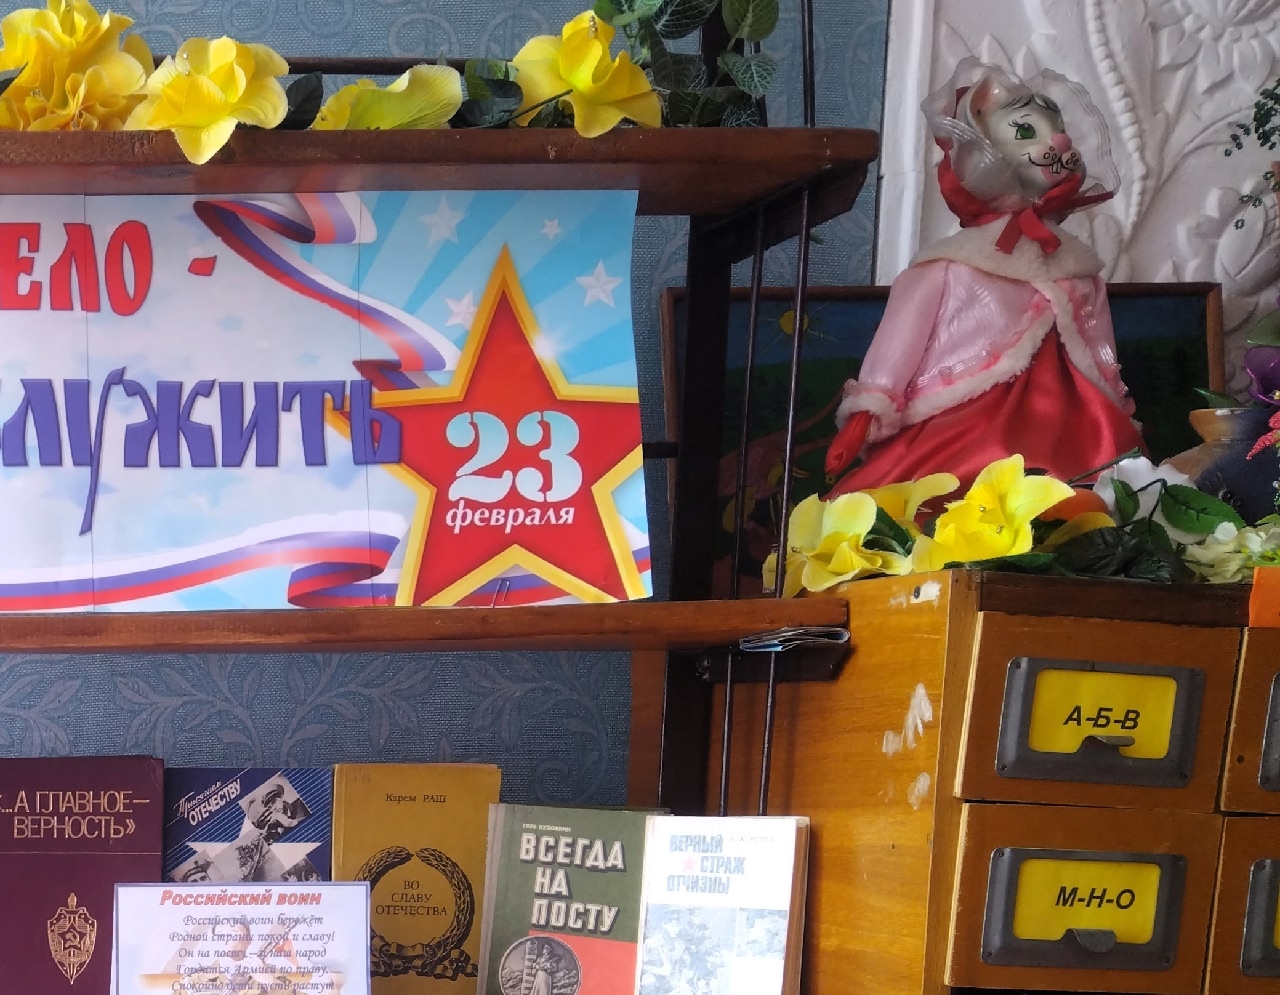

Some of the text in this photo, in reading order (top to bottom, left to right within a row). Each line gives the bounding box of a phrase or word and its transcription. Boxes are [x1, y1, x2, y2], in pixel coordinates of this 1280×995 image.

[446, 411, 583, 503] 23
[446, 501, 575, 533] февраля
[1064, 706, 1141, 730] А-Б-В
[189, 778, 240, 826] ОТЕЧЕСТВУ
[385, 794, 447, 803] Карем РАШ
[13, 815, 136, 839] ВЕРНОСТЬ»
[520, 832, 625, 871] ВСЕГДА
[669, 833, 724, 854] ВЕРНЫЙ
[700, 855, 747, 875] СТРАЖ
[403, 880, 420, 891] ВО
[533, 866, 570, 897] НА
[666, 874, 731, 895] ОТЧИЗНЫ
[391, 892, 433, 903] СЛАВУ
[1056, 887, 1136, 911] М-Н-О
[375, 905, 448, 917] ОТЕЧЕСТВА
[530, 898, 620, 932] ПОСТУ
